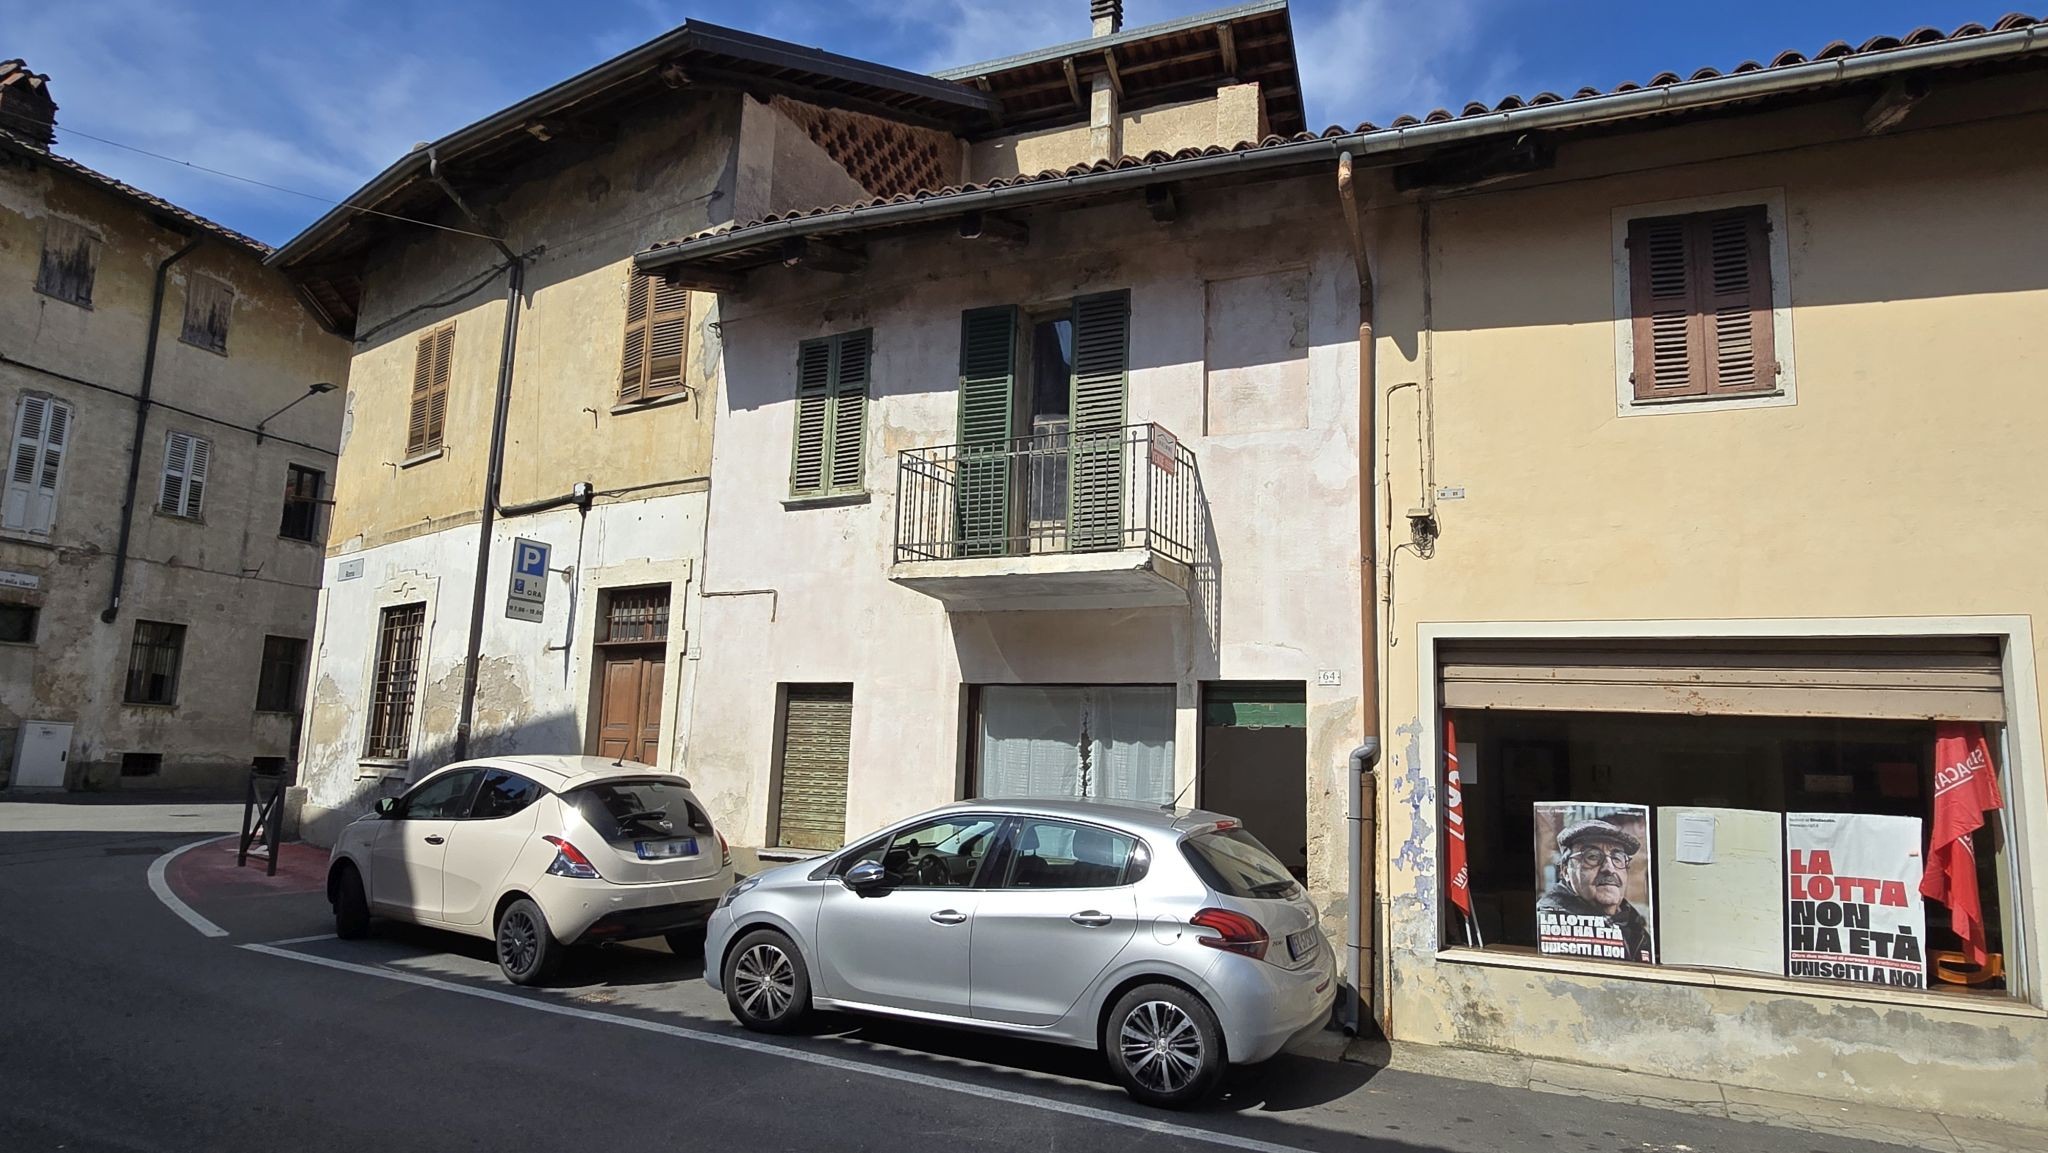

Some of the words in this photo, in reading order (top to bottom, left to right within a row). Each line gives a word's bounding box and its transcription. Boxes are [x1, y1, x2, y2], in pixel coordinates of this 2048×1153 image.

[523, 547, 541, 571] P
[526, 589, 542, 598] ORA
[1322, 671, 1335, 681] 64
[1790, 849, 1833, 875] LA
[1790, 875, 1909, 908] LOTTA
[1540, 913, 1558, 925] LA
[1559, 914, 1605, 928] LOTTA
[1790, 900, 1870, 930] NON
[1540, 924, 1572, 936] NON
[1573, 925, 1595, 938] HA
[1595, 924, 1624, 941] ETÀ
[1791, 926, 1842, 953] HA
[1849, 925, 1922, 963] ETÀ
[1541, 941, 1592, 955] UNISCITI
[1593, 944, 1602, 957] A
[1603, 945, 1625, 959] NOI
[1791, 961, 1869, 981] UNISCITI
[1872, 967, 1886, 984] A
[1889, 969, 1922, 989] NOI
